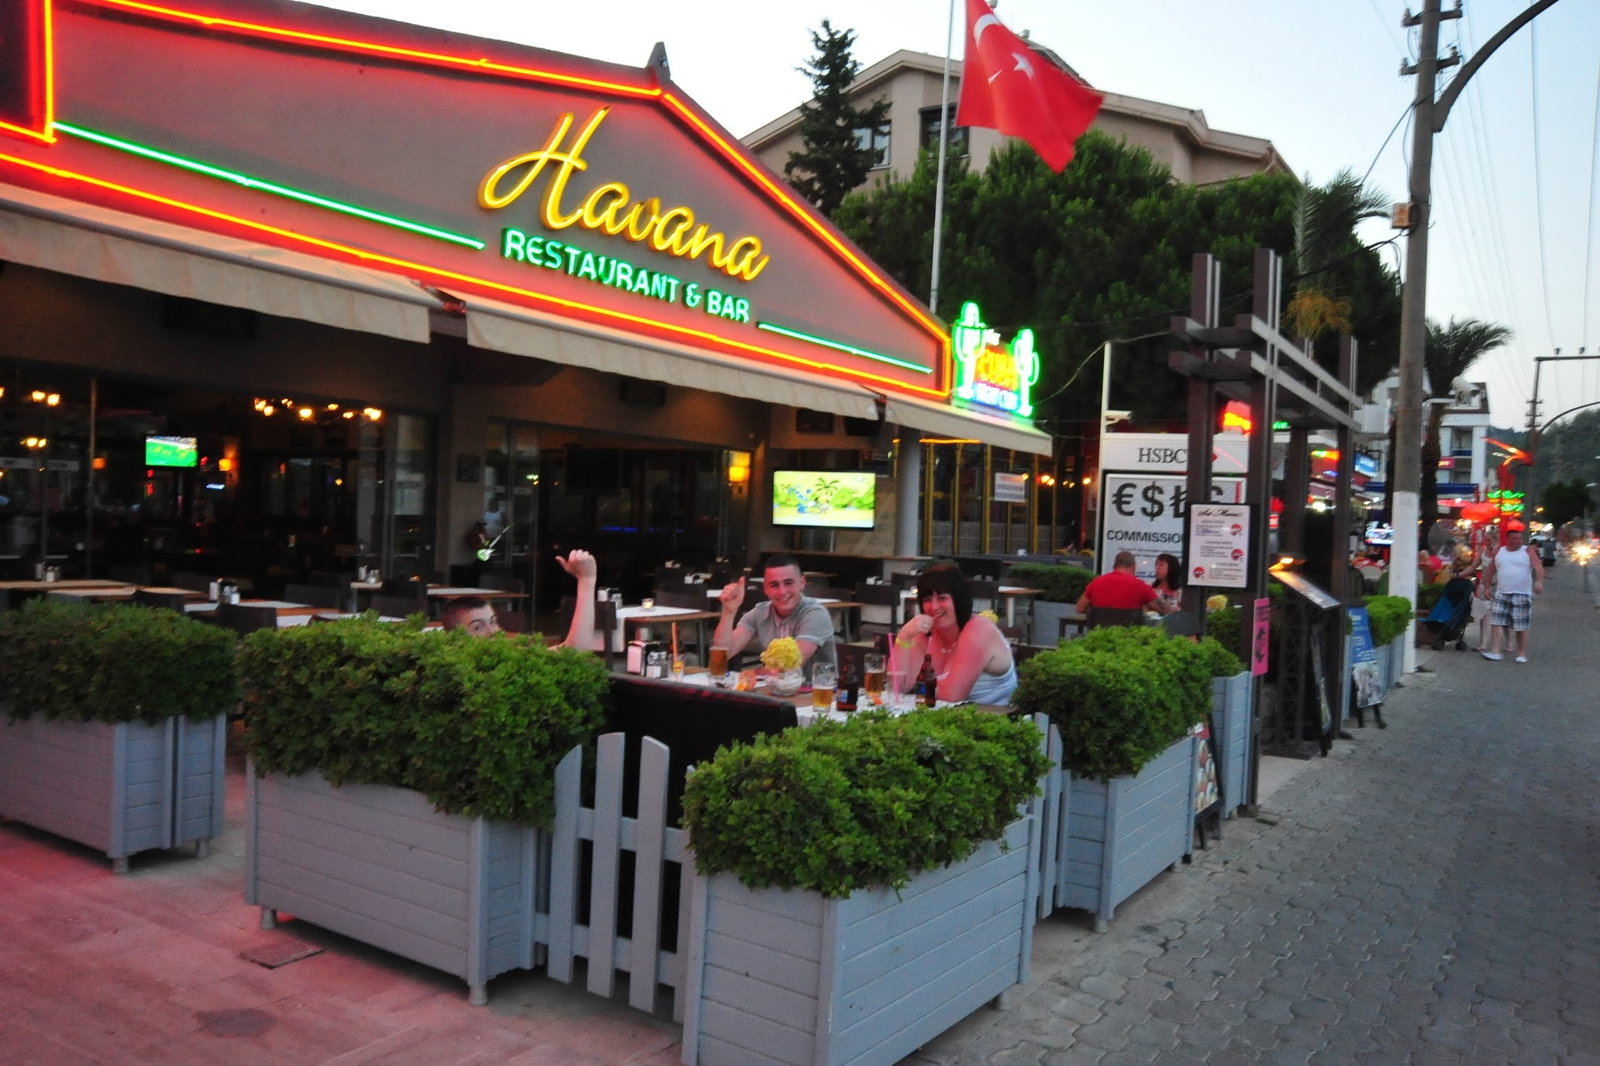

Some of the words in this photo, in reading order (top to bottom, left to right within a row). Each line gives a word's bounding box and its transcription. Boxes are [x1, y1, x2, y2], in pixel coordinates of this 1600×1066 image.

[478, 106, 770, 281] Havana
[503, 227, 680, 303] RESTAURANT
[683, 281, 702, 308] &
[705, 288, 750, 324] BAR
[1137, 447, 1188, 464] HSBC
[1106, 529, 1184, 544] COMMISSIO
